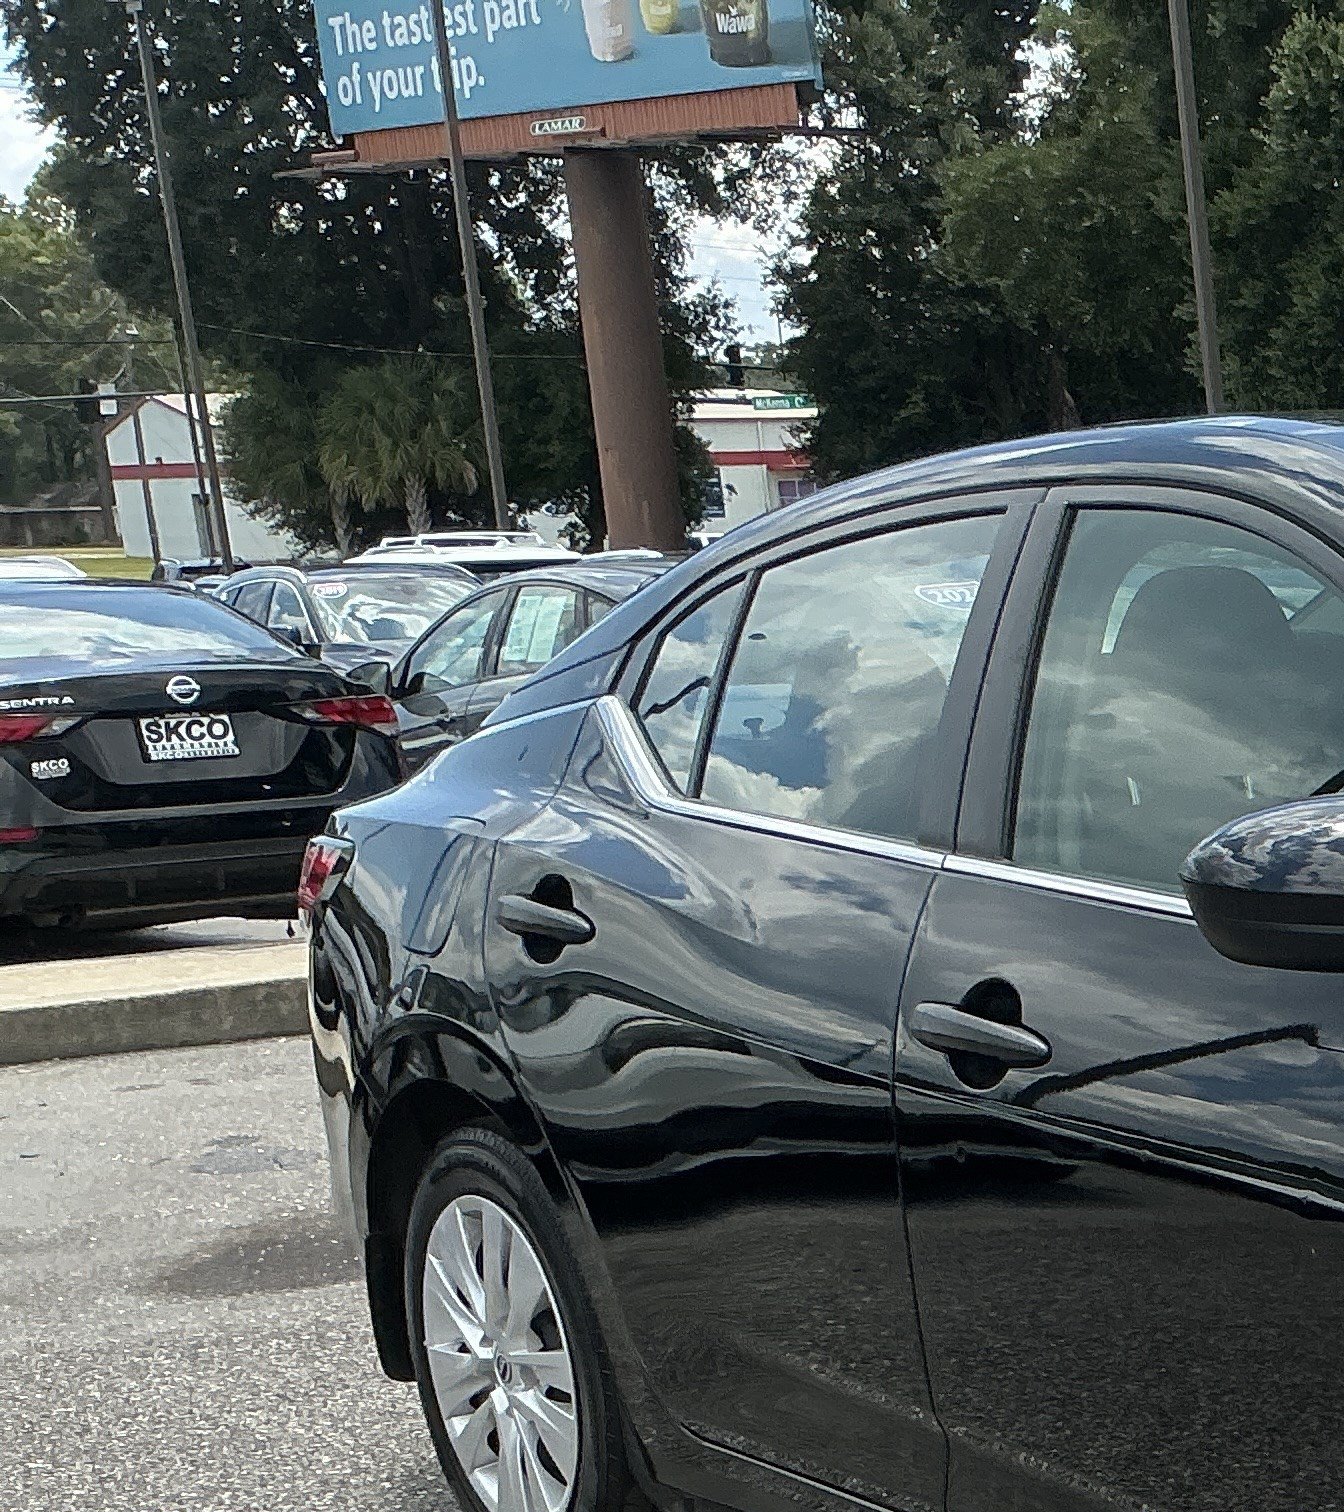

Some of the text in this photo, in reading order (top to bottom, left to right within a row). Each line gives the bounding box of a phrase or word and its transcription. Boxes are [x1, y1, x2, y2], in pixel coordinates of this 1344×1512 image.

[328, 0, 541, 56] The tastest part
[337, 46, 485, 113] of your tip.
[535, 118, 580, 134] LAMAR
[145, 718, 230, 743] SKCO
[31, 758, 69, 773] SKCO
